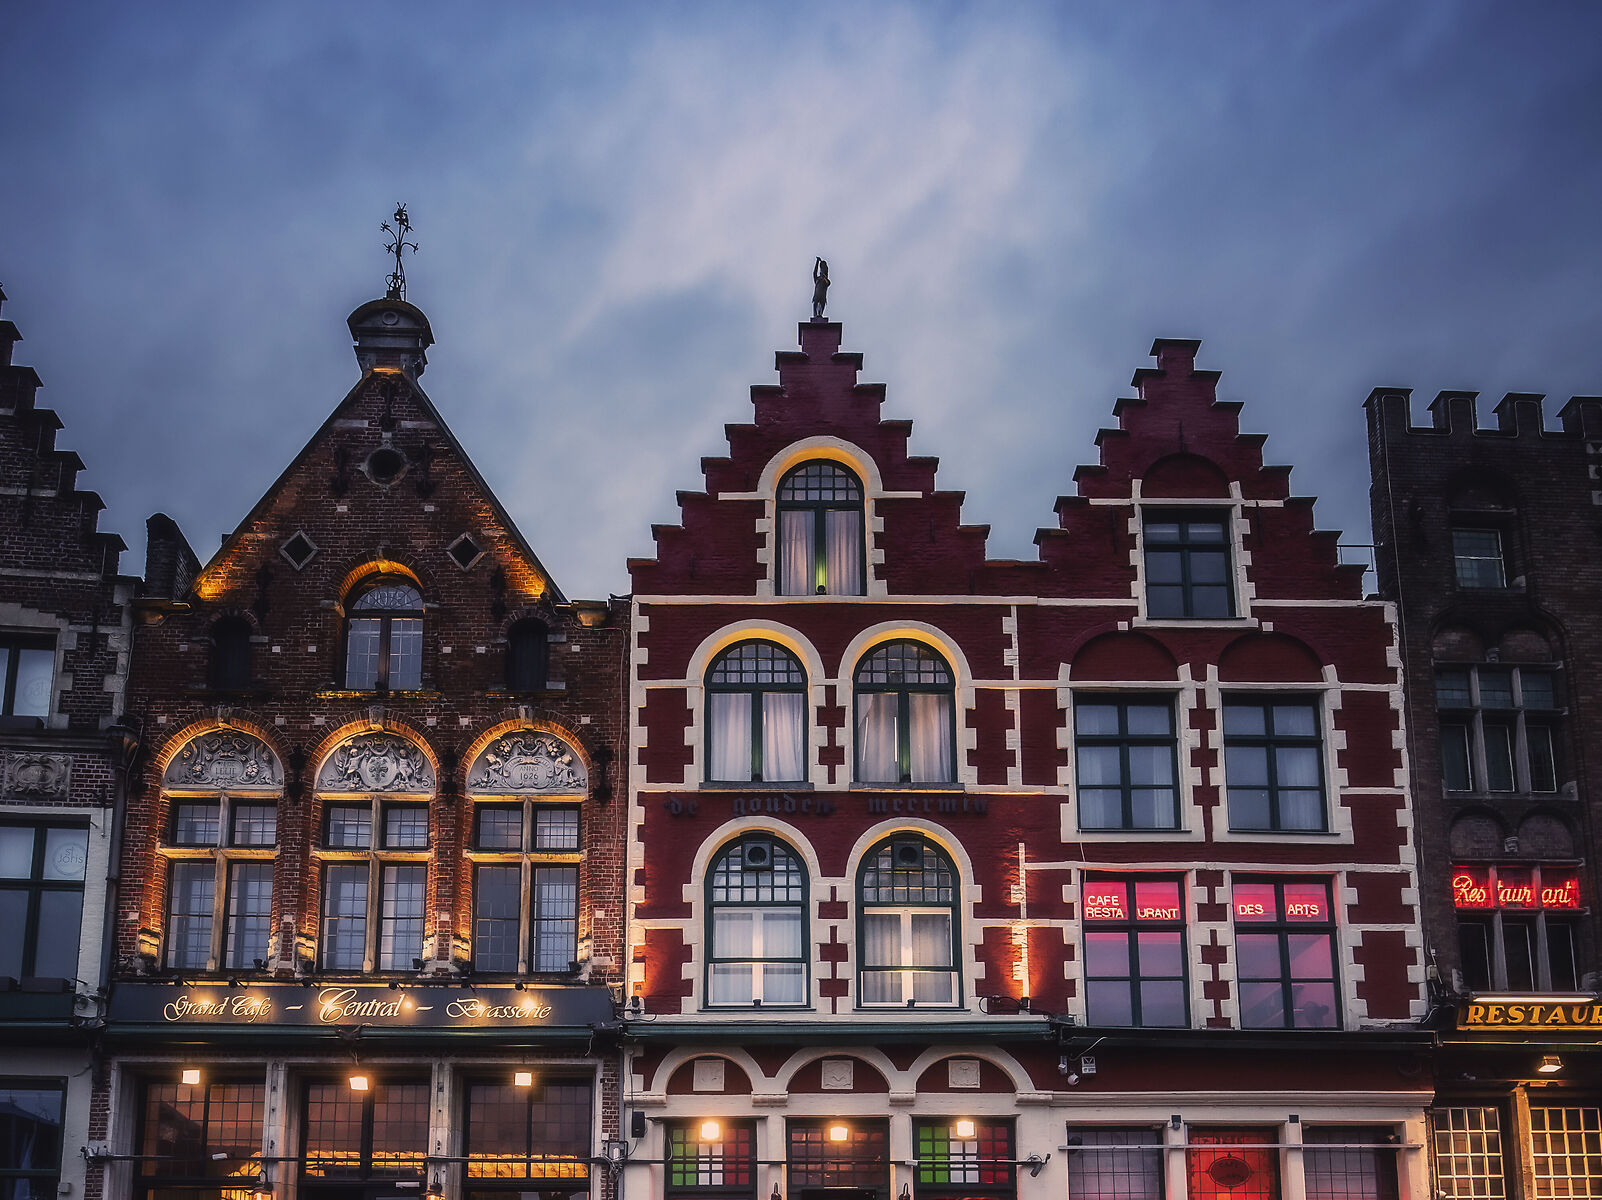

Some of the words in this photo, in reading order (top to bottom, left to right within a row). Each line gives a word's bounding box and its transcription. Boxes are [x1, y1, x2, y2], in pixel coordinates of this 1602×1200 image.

[1087, 895, 1120, 906] CAFE
[1238, 904, 1264, 915] DES
[1287, 903, 1320, 915] ARTS
[163, 995, 230, 1021] Grand
[318, 987, 406, 1023] Central
[446, 997, 552, 1019] Brasserie
